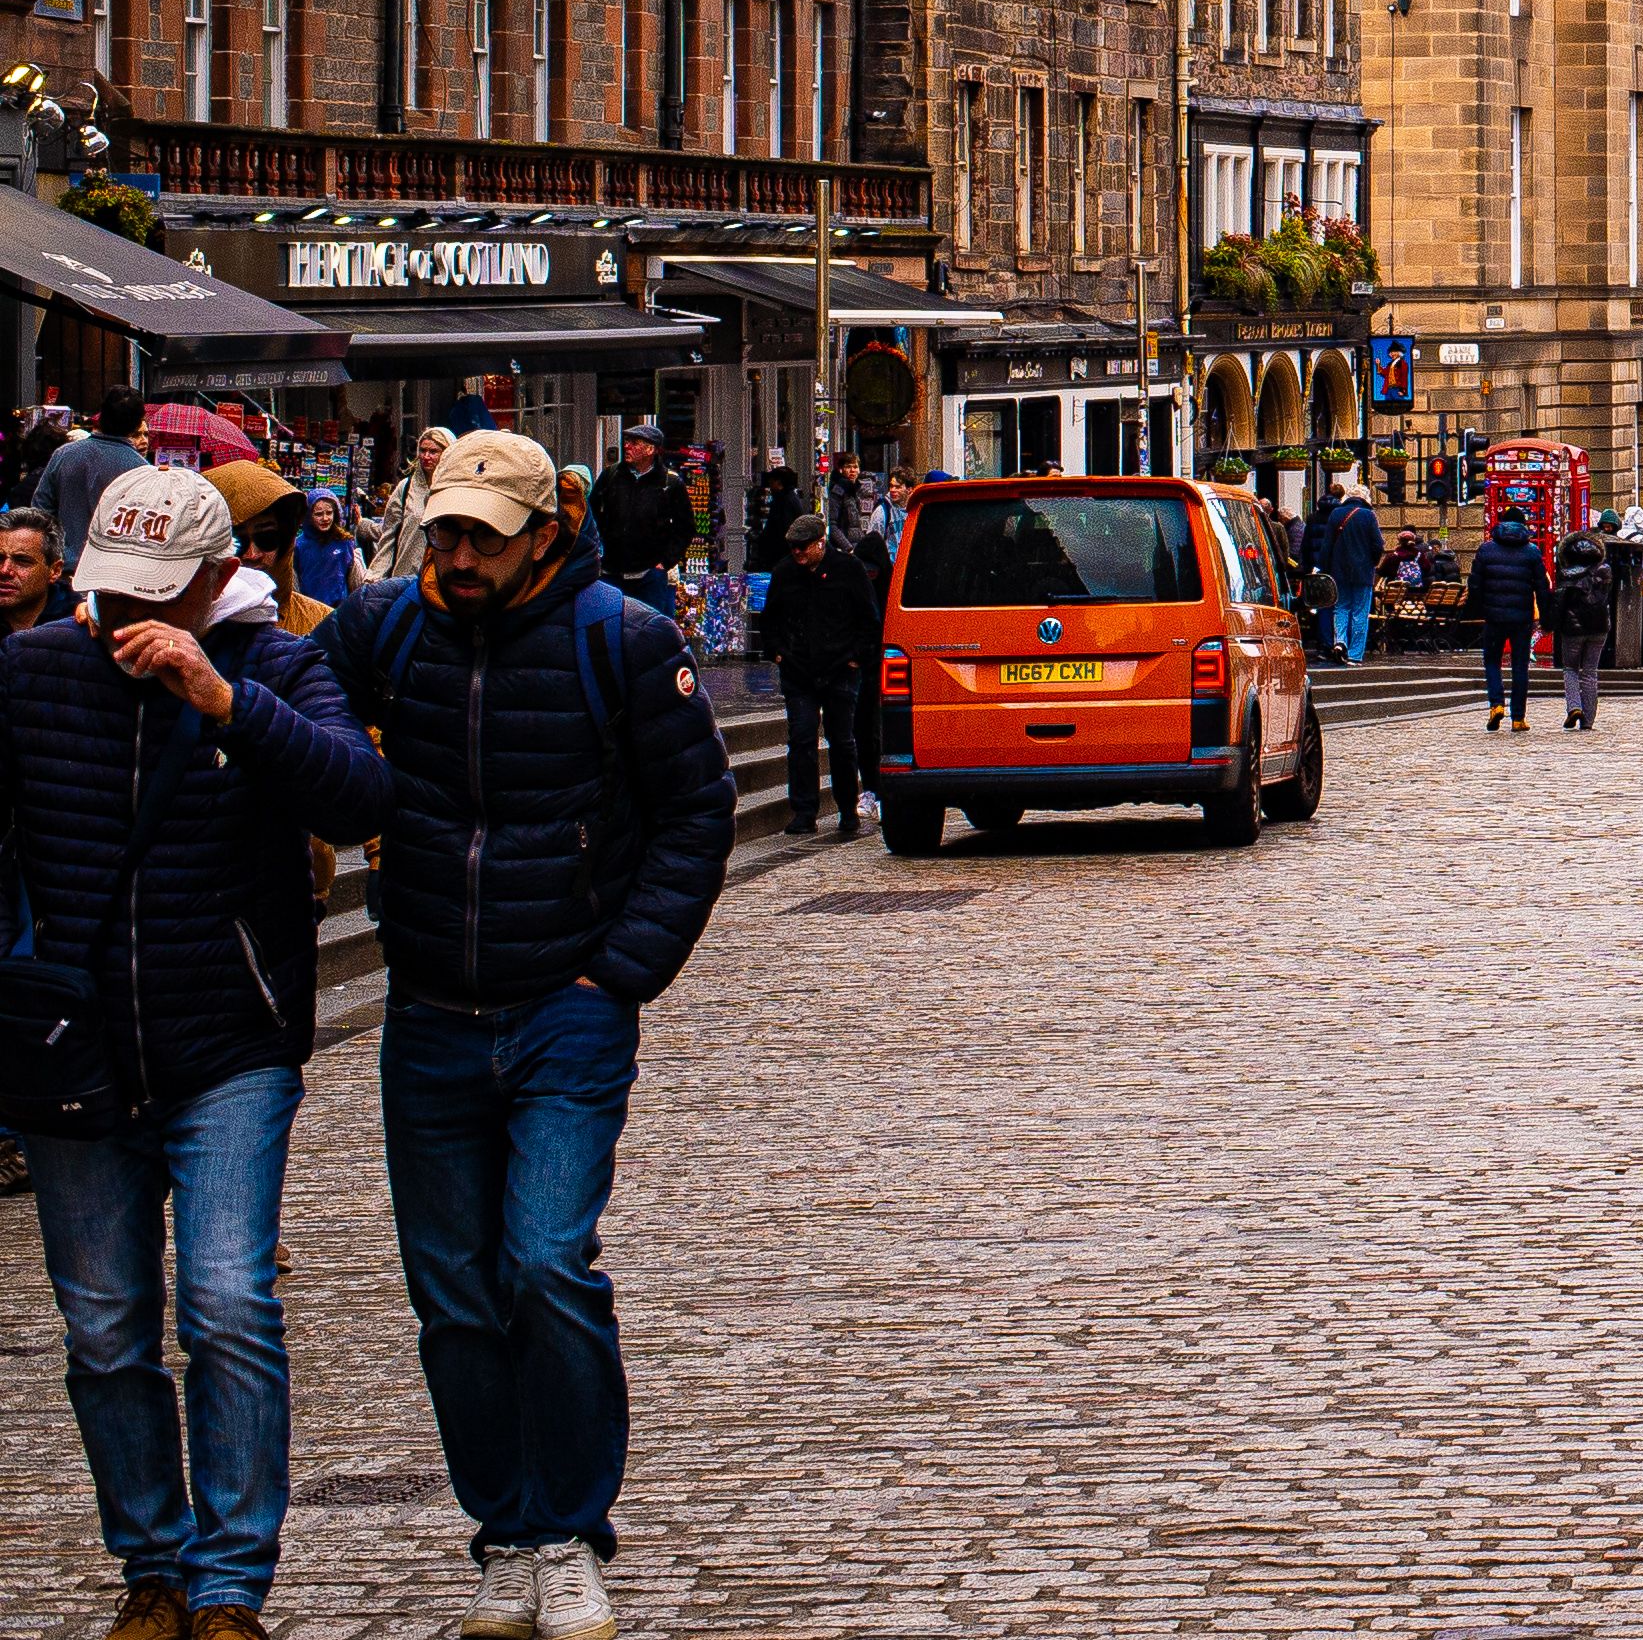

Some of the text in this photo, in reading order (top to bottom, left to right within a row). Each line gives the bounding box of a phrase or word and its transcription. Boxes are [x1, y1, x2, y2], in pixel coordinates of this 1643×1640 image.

[288, 241, 410, 287] HERITAGE
[434, 241, 550, 286] SCOTLAND
[1007, 662, 1096, 681] HG67 CXH
